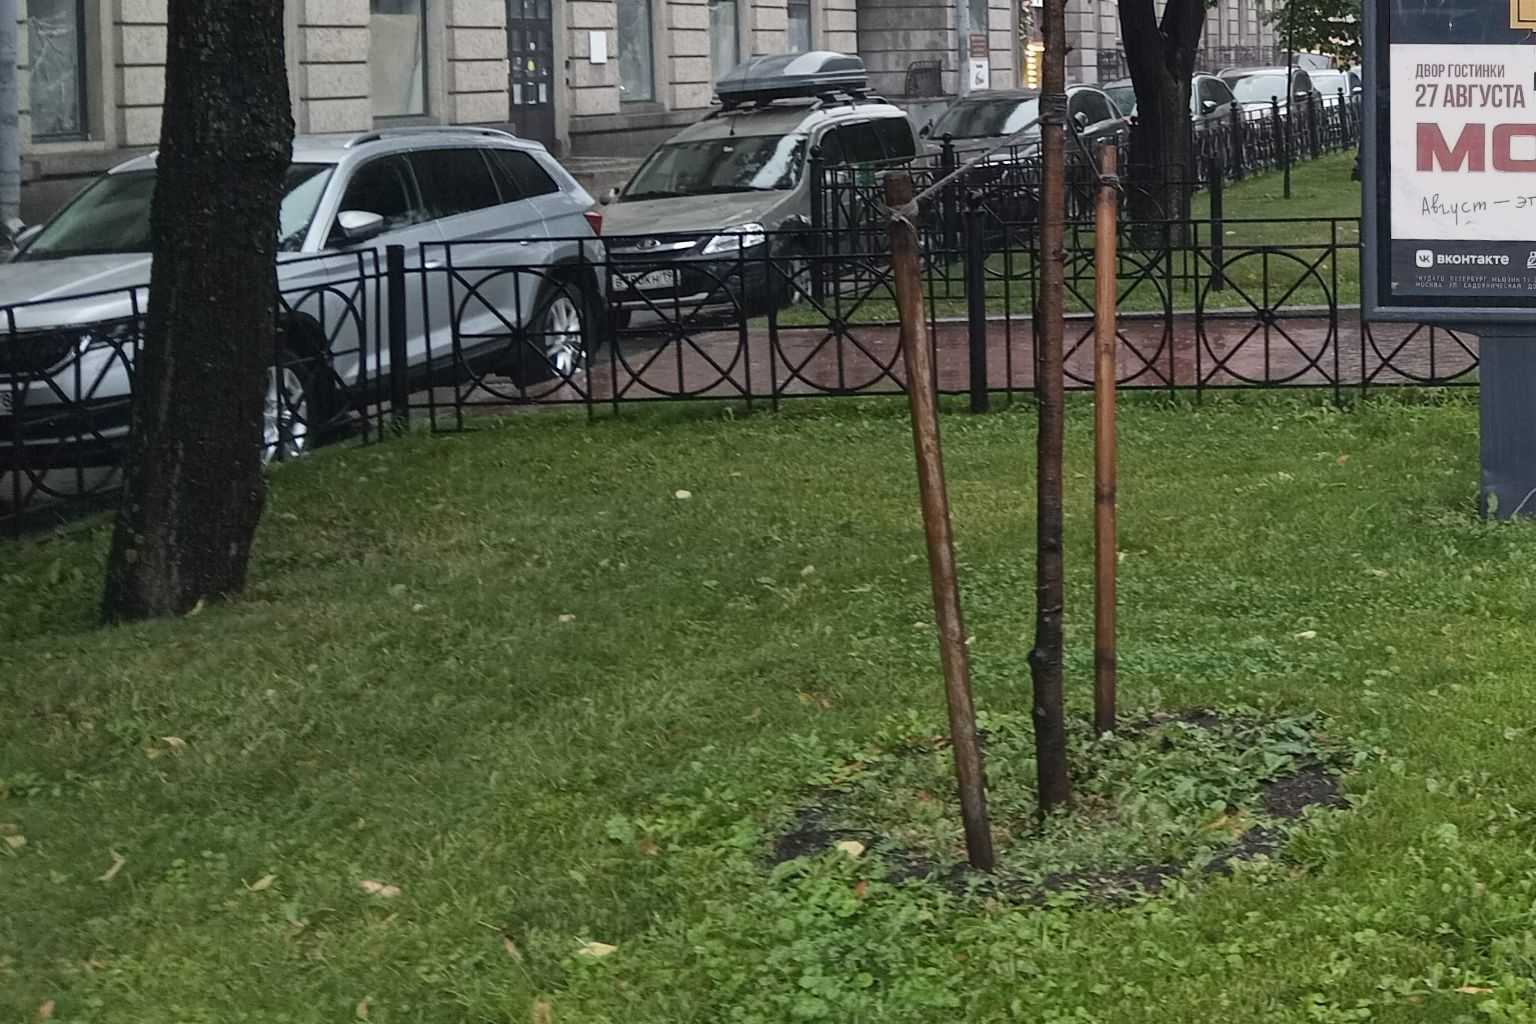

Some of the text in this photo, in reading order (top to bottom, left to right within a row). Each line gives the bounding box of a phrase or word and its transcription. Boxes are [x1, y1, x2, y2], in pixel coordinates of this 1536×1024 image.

[1415, 63, 1505, 79] ДВОР ГОСТИНКИ
[1415, 84, 1526, 109] 27 АВГУСТА
